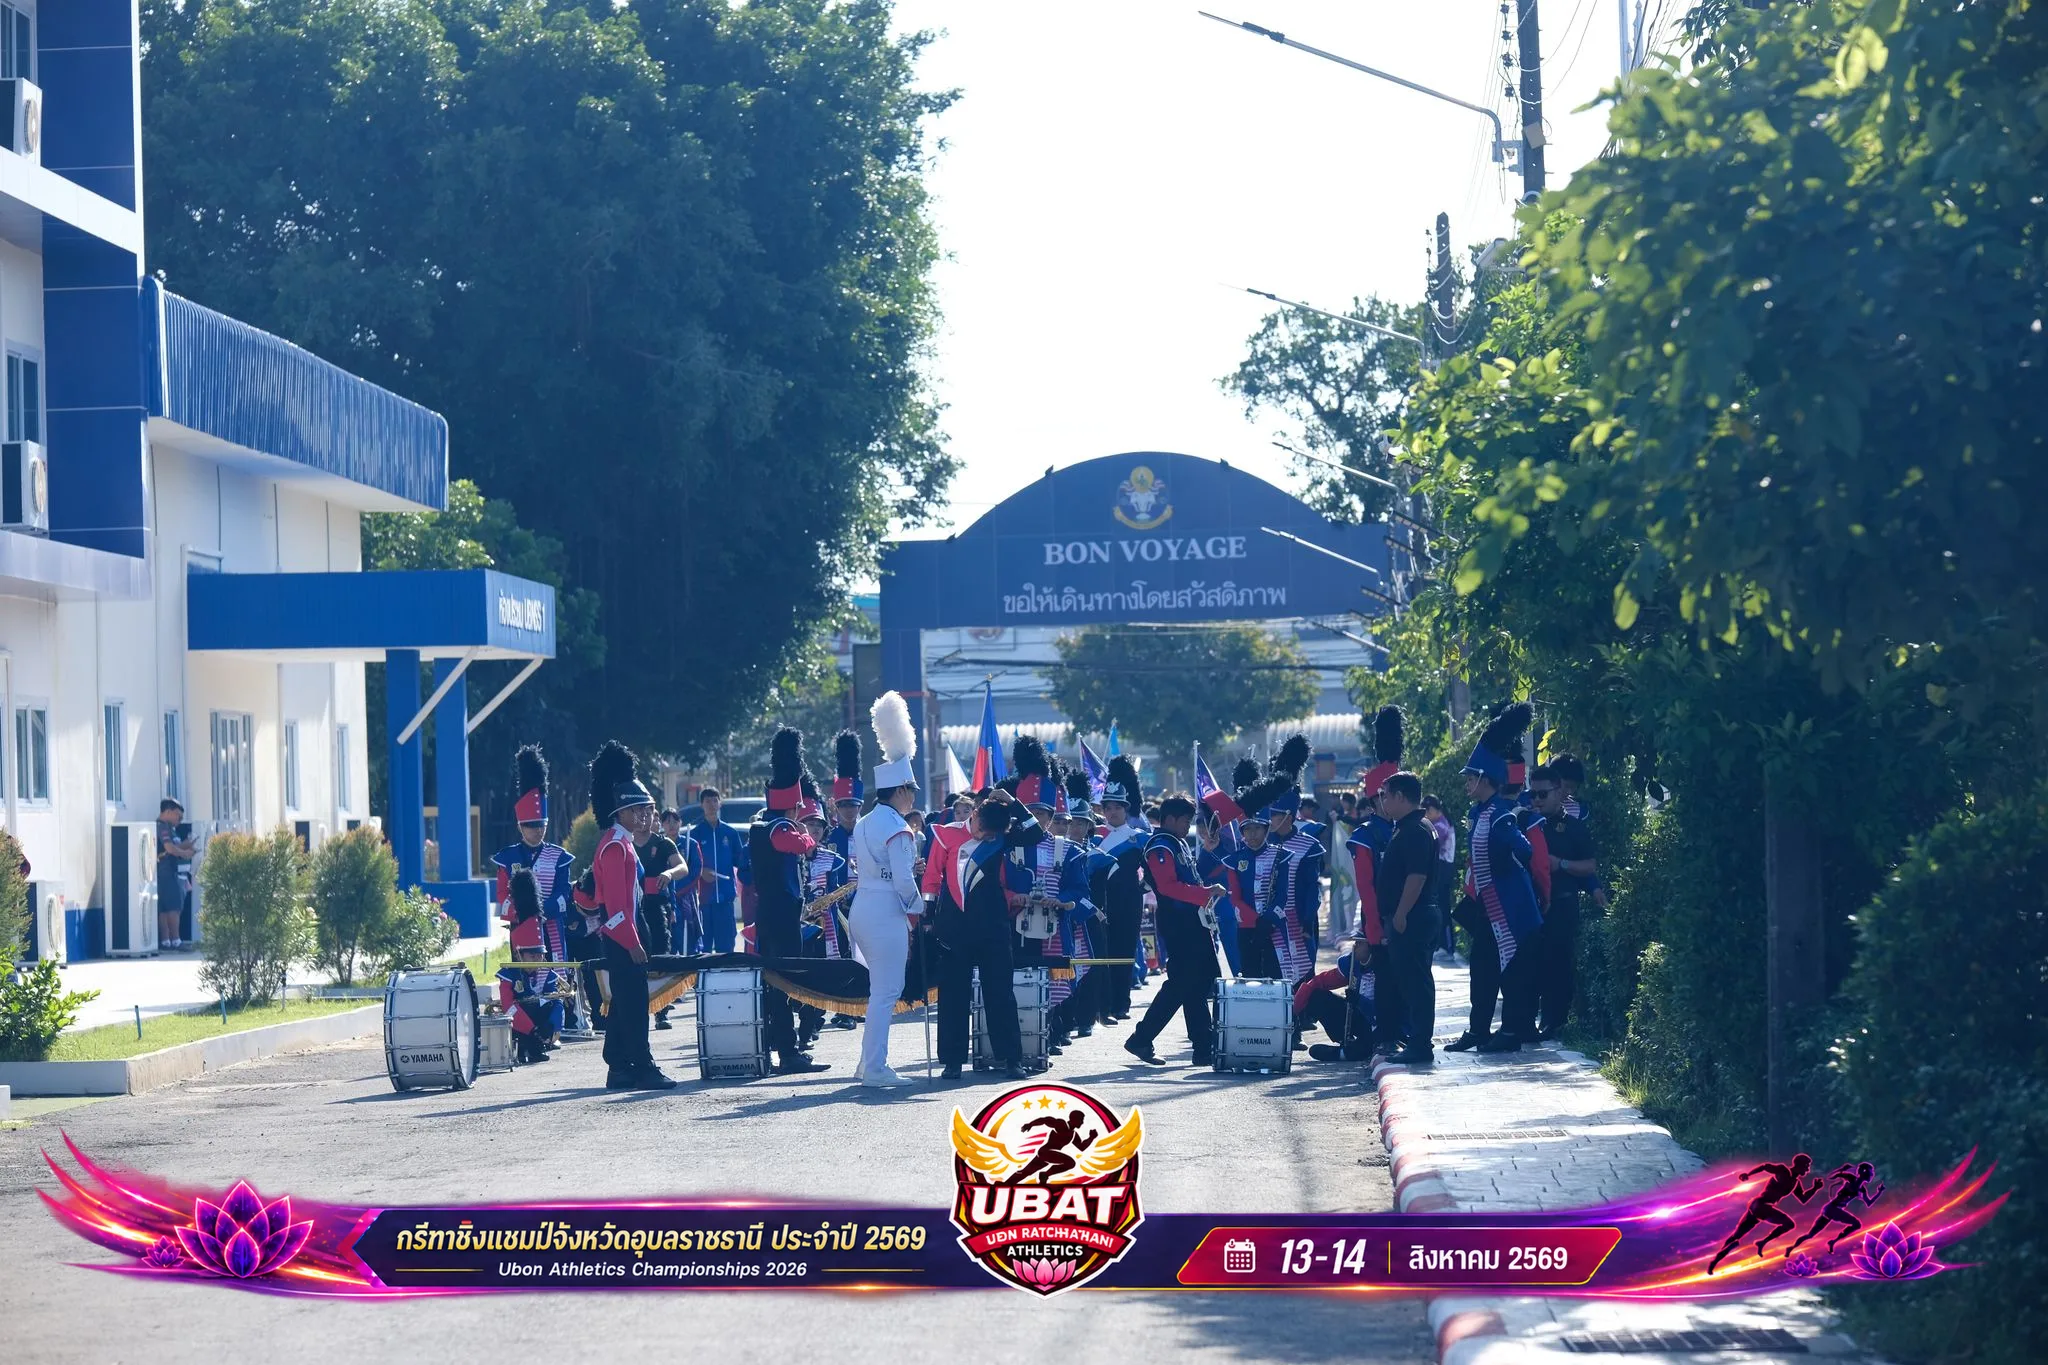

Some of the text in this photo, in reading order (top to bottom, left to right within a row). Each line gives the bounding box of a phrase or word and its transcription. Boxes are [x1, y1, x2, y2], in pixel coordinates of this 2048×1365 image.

[1044, 536, 1247, 566] BON VOYAGE
[1003, 580, 1287, 614] ขอให้เดินทางโดยสวัสดิภาพ
[1246, 1037, 1272, 1046] YAMAHA
[411, 1053, 445, 1064] YAMAHA
[723, 1063, 756, 1071] YAMAHA
